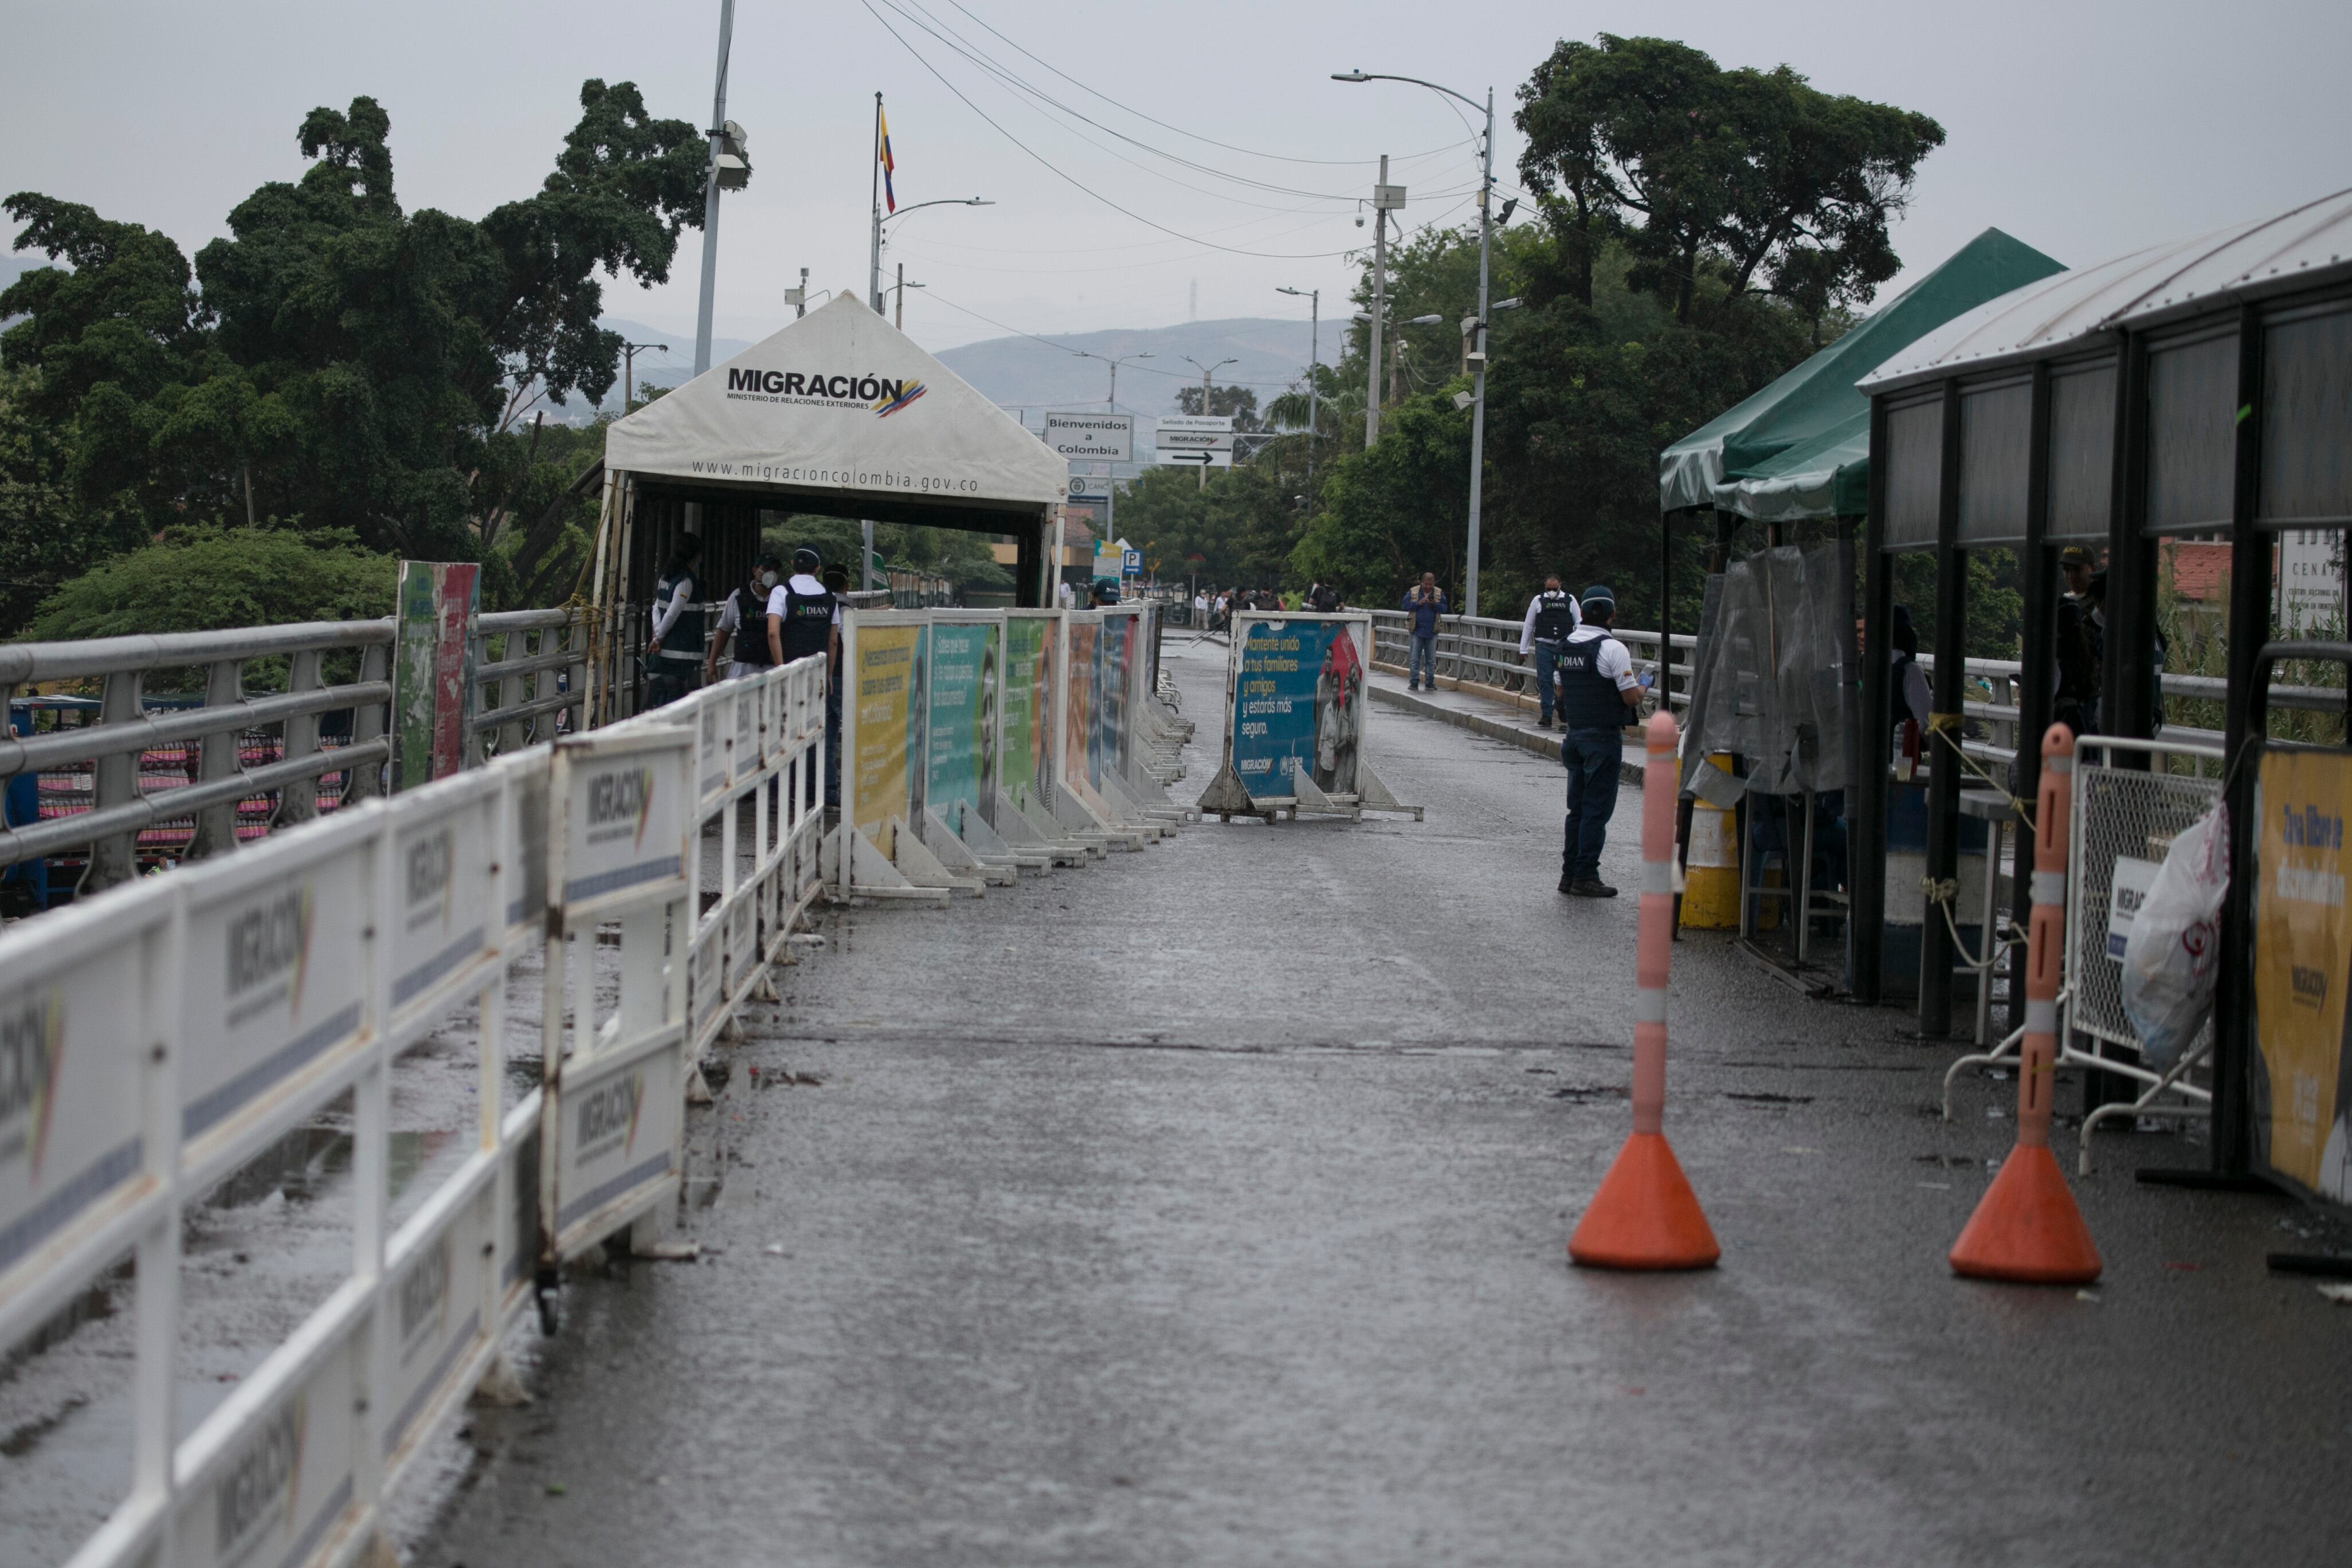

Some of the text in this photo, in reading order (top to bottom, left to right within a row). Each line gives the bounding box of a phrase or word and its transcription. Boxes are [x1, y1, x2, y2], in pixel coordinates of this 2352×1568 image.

[728, 368, 903, 402] MIGRACIÓN
[727, 393, 769, 402] MINISTERIO
[781, 397, 825, 406] RELACIONES
[826, 401, 869, 410] EXTERIORES
[1049, 419, 1128, 430] Bienvenidos
[1057, 445, 1119, 455] Colombia
[692, 460, 978, 492] www.migracioncolombia.gov.co
[1129, 553, 1136, 565] P
[806, 606, 828, 616] DIAN
[1280, 635, 1300, 651] unido
[1245, 656, 1298, 672] a tus familiares
[1564, 656, 1584, 667] DIAN
[1244, 676, 1276, 697] y amigos
[1242, 696, 1292, 718] y estarás más
[1242, 722, 1268, 739] seguro.
[1241, 756, 1271, 771] MIGRACIÓN
